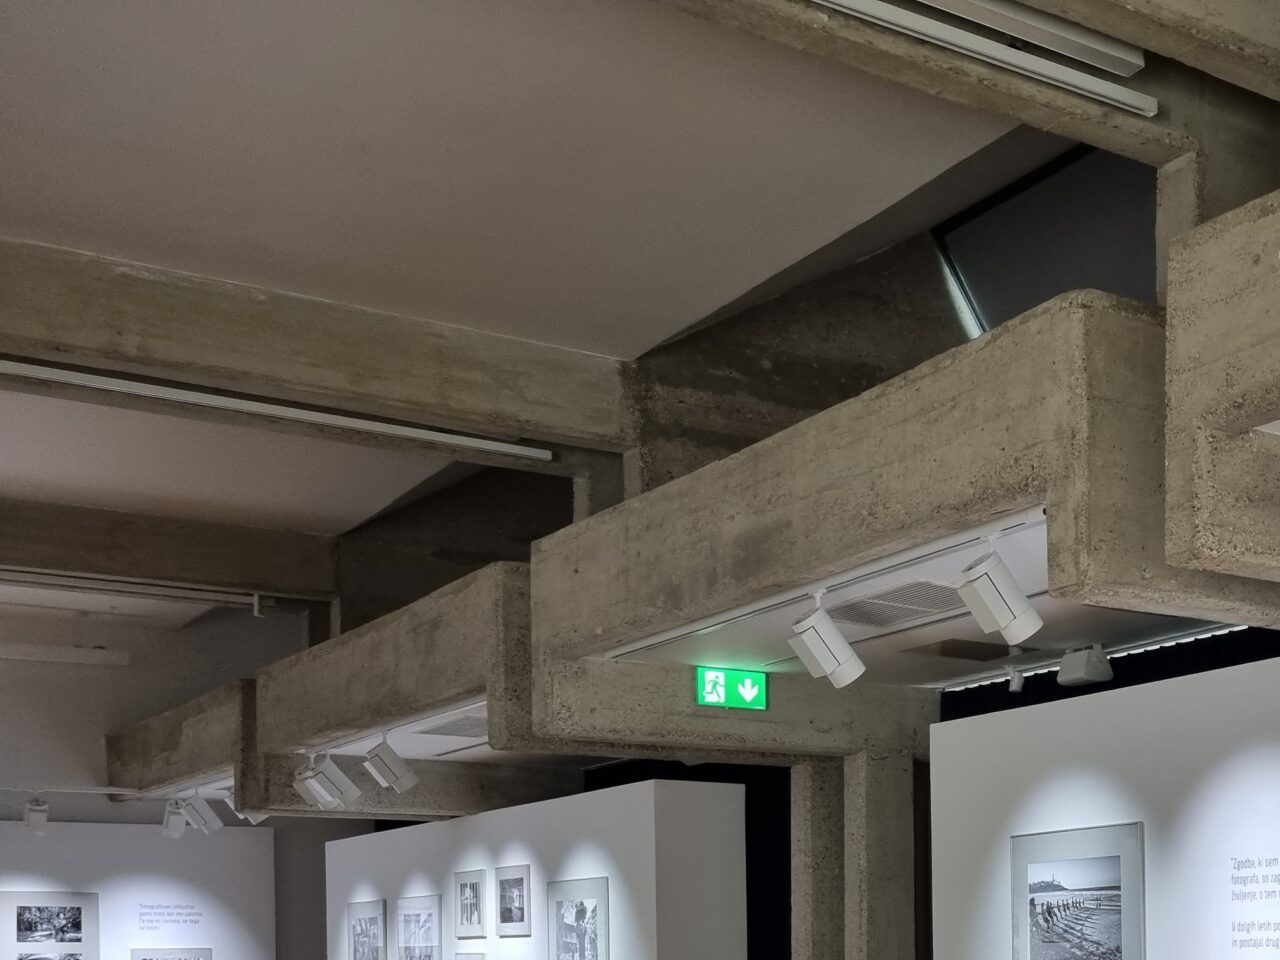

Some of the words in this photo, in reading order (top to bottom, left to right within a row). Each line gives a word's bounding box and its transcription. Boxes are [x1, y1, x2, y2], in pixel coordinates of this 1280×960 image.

[1258, 856, 1263, 867] ki
[1265, 857, 1278, 867] sem
[1231, 873, 1260, 887] fotografa,
[1262, 874, 1269, 883] so
[1232, 889, 1258, 902] življenje,
[1265, 889, 1278, 899] tem
[1237, 921, 1256, 934] dolgih
[1257, 920, 1272, 931] letih
[1232, 938, 1238, 947] in
[1239, 937, 1264, 949] postajal
[1265, 937, 1280, 949] drug
